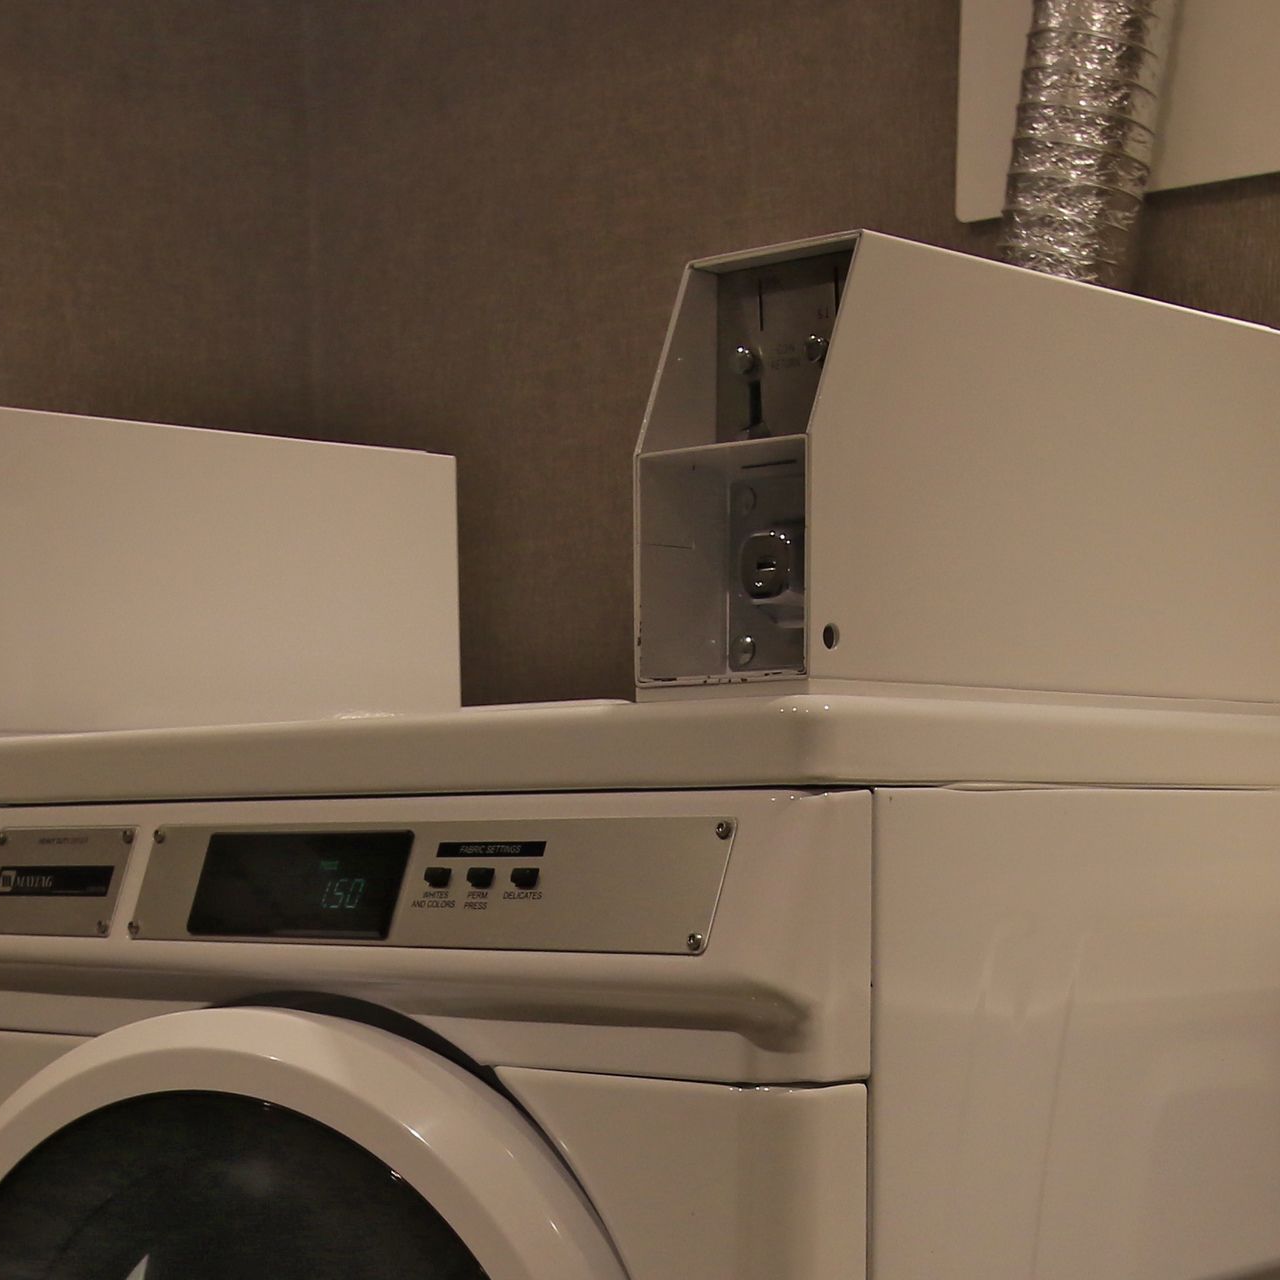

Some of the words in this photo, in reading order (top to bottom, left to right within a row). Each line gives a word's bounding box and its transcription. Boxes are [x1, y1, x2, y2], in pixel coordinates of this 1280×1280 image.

[458, 844, 483, 854] FABRIC
[486, 844, 522, 854] SETTINGS
[16, 875, 54, 888] MAYTAG
[422, 890, 449, 899] WHITES
[503, 890, 543, 900] DELICATES
[410, 899, 426, 908] AND
[426, 899, 455, 908] COLORS
[464, 901, 488, 910] PRESS
